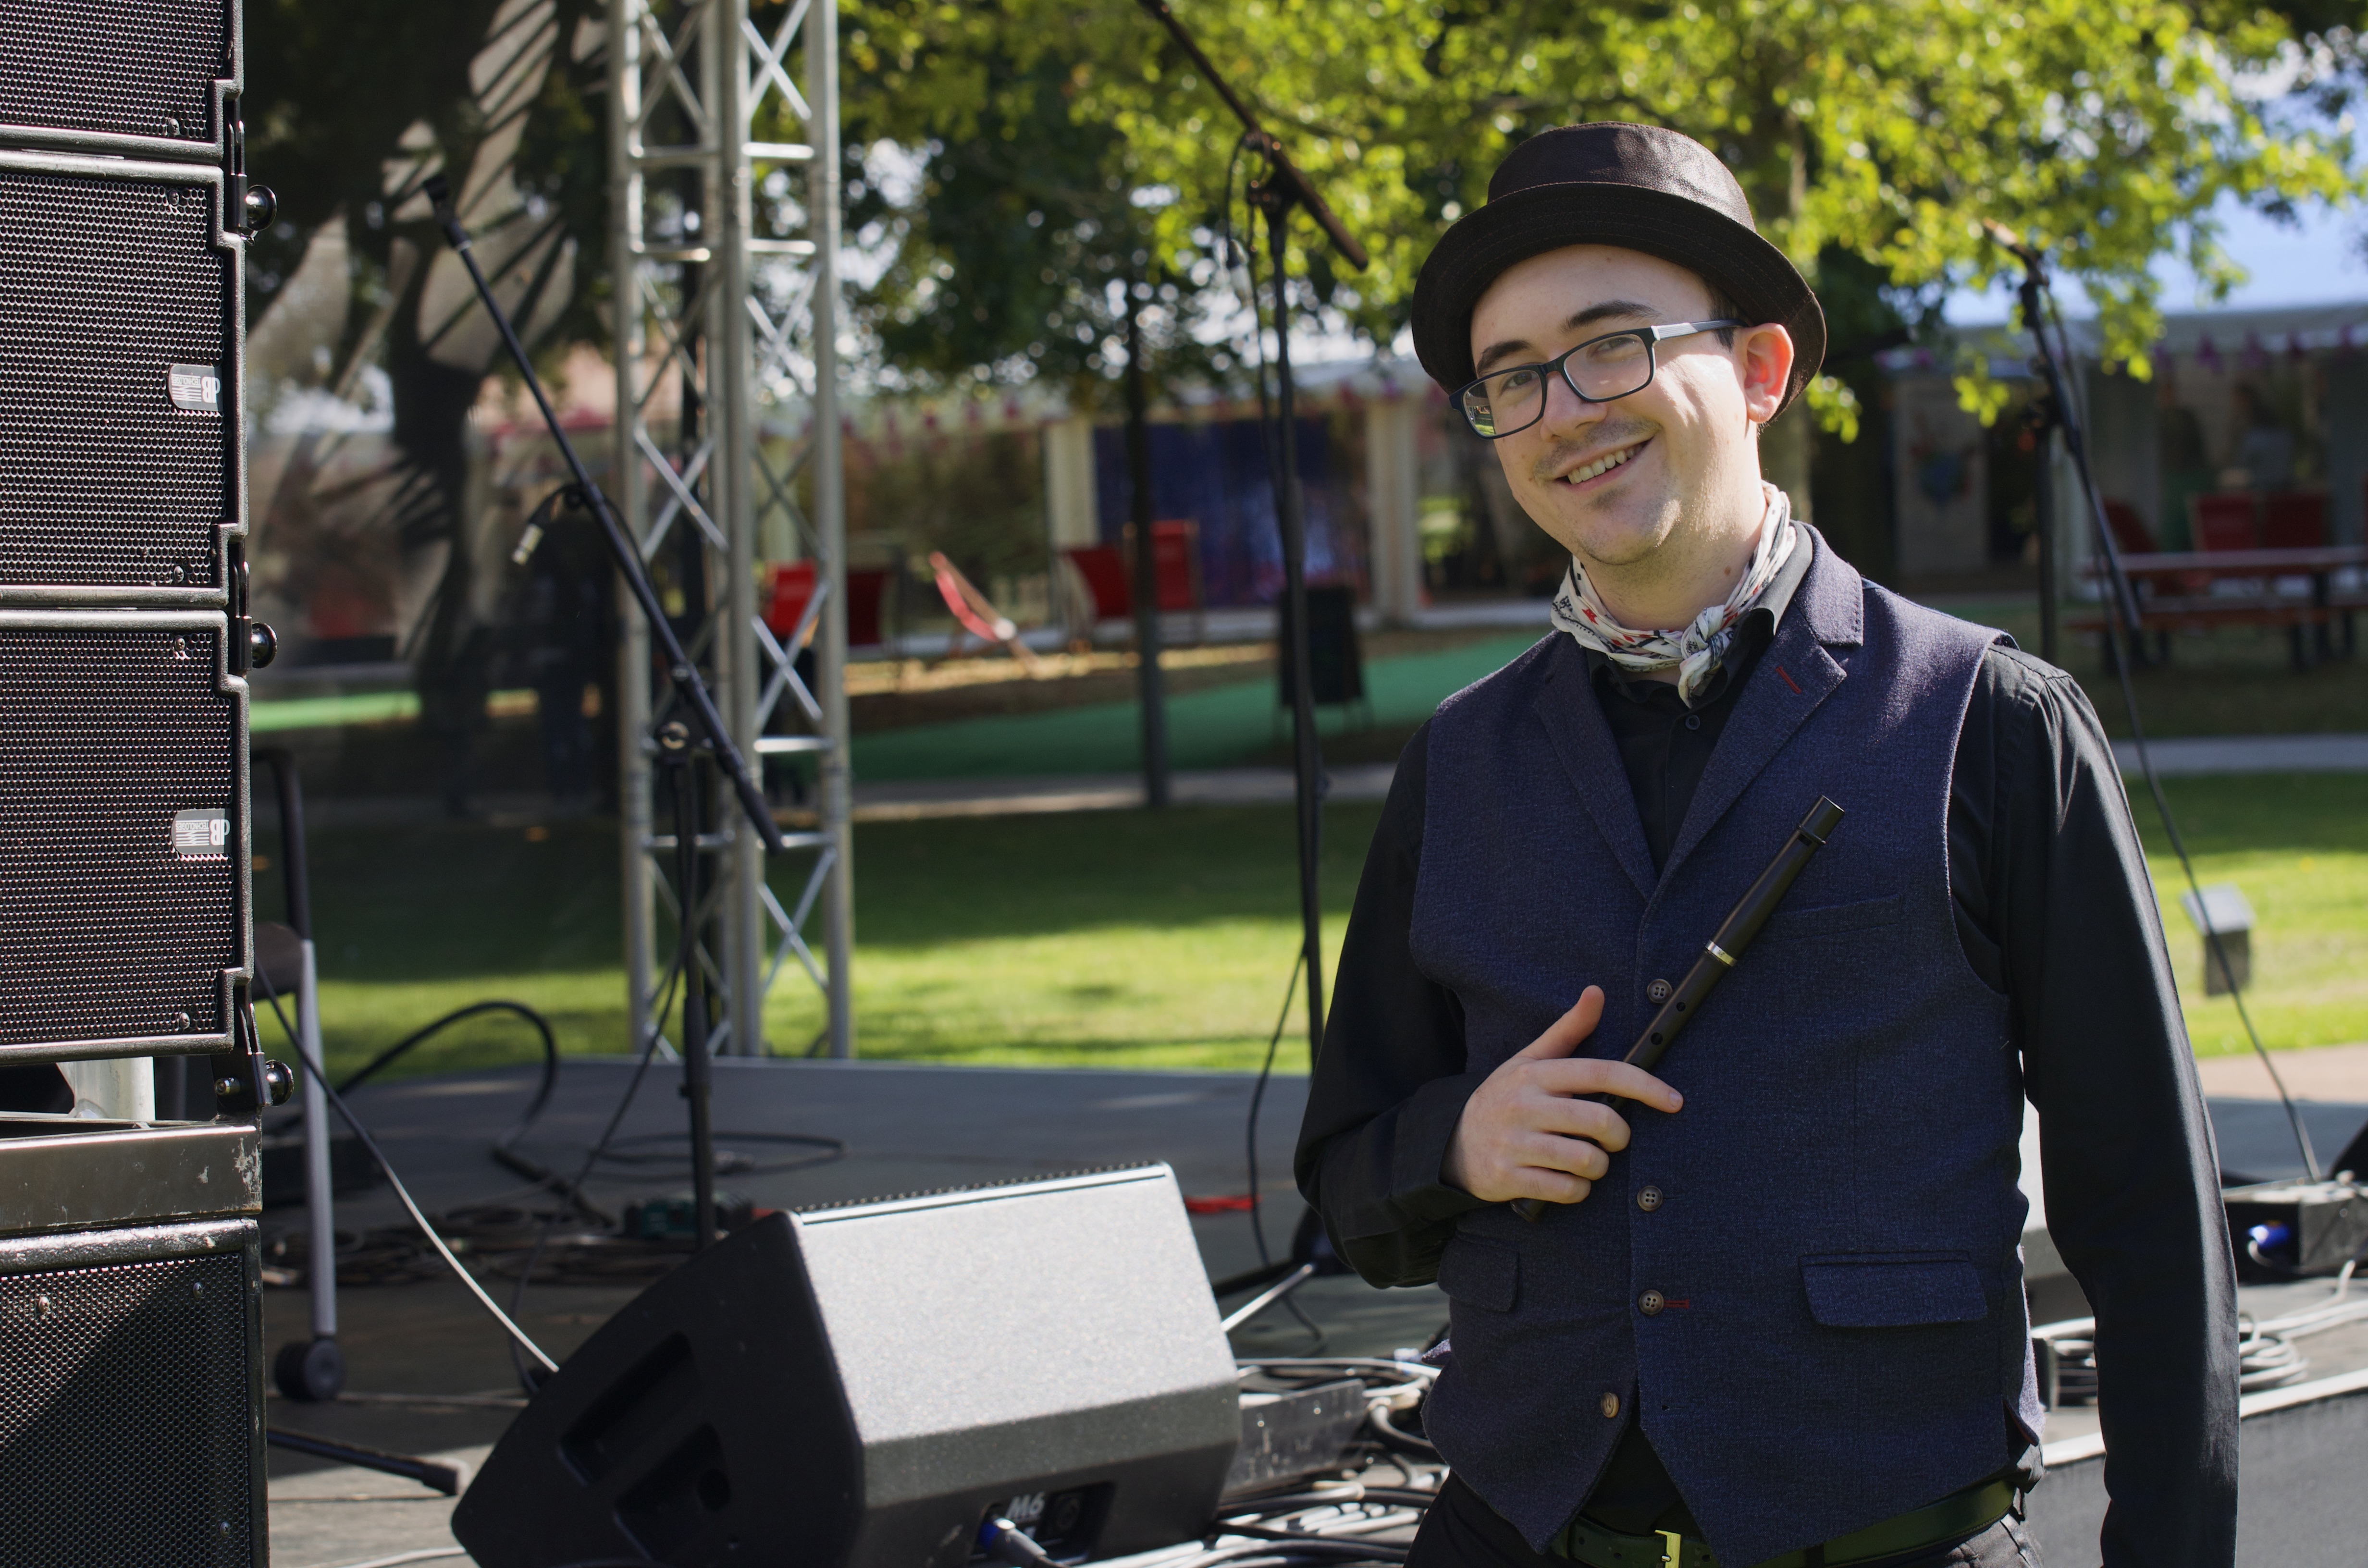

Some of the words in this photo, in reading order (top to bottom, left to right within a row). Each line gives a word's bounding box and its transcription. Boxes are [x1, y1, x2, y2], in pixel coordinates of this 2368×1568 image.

[172, 376, 201, 385] TECHNOLOGIES
[201, 376, 221, 403] dB
[176, 822, 209, 830] TECHNOLOGIES
[210, 819, 230, 845] dB
[1005, 1491, 1045, 1520] M6
